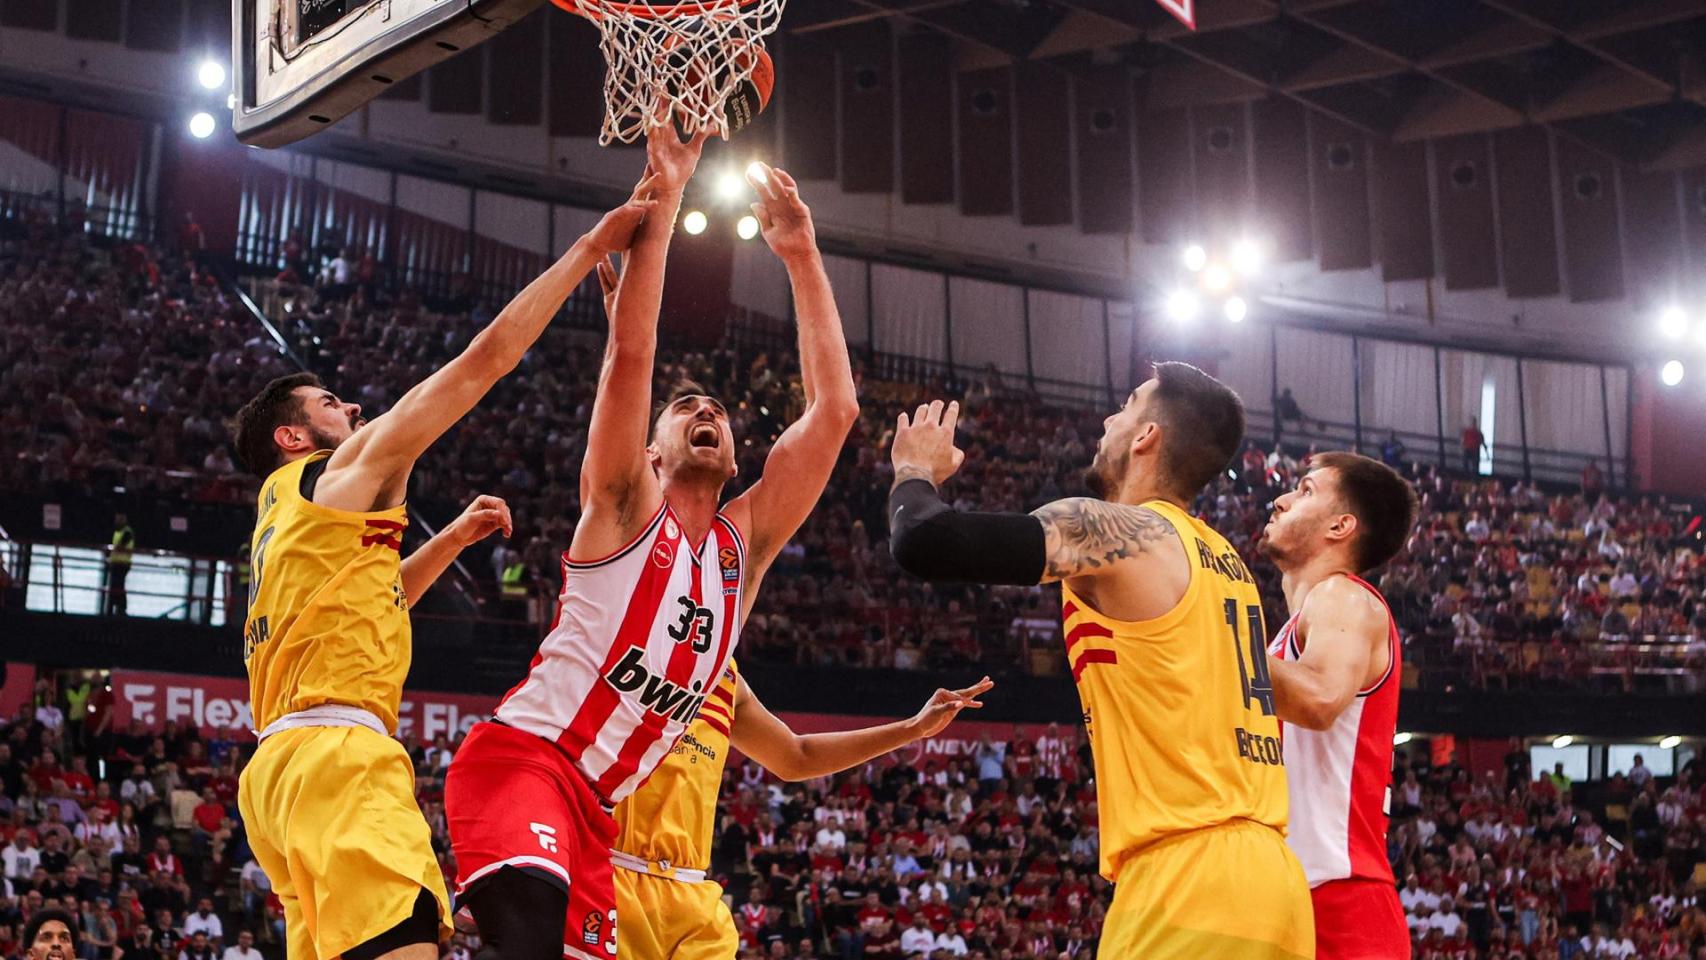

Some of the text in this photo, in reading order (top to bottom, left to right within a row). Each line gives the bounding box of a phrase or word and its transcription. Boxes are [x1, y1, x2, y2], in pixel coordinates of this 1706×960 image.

[667, 595, 714, 654] 33
[1223, 598, 1276, 716] 14
[166, 686, 254, 730] Flex
[605, 645, 707, 725] bwin
